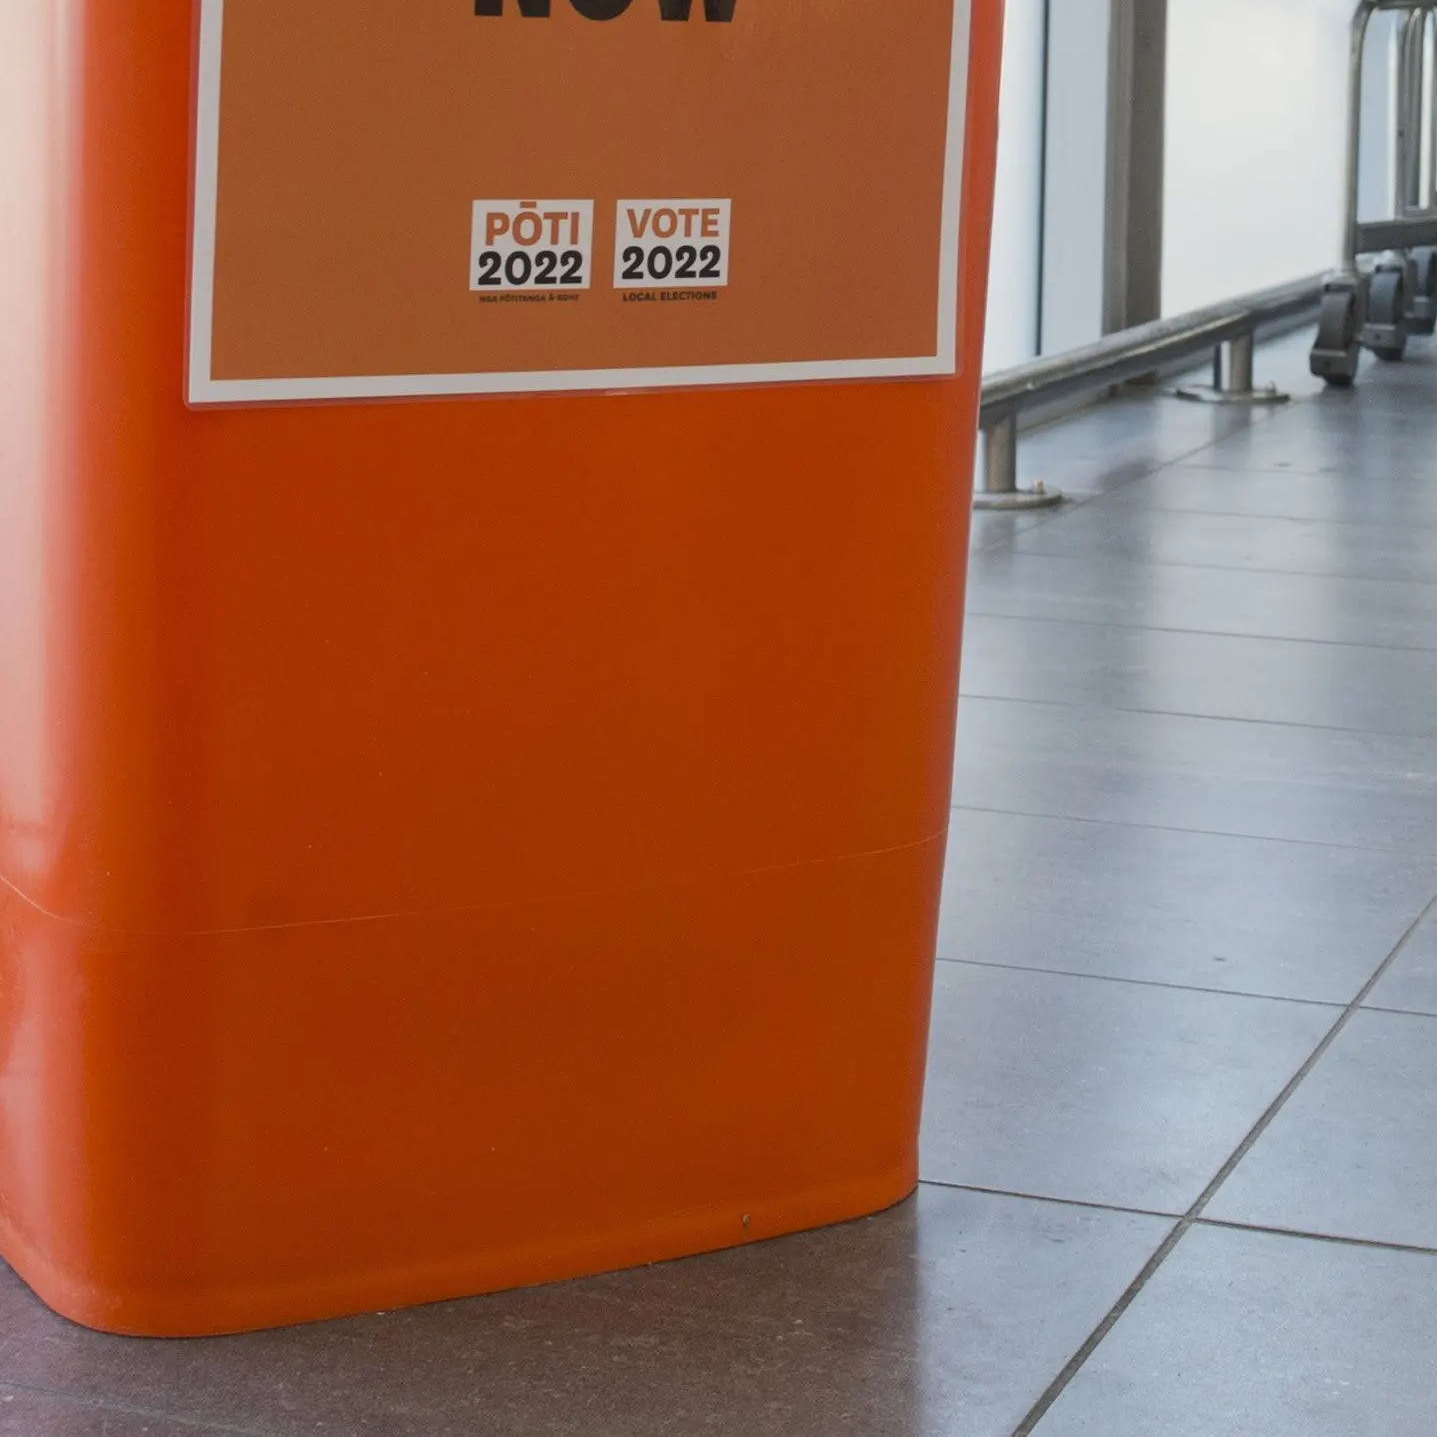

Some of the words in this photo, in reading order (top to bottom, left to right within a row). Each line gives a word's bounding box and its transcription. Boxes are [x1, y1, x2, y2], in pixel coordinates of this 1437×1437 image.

[484, 201, 580, 246] PŌTI
[626, 208, 720, 239] VOTE
[477, 250, 583, 286] 2022
[621, 245, 721, 280] 2022
[622, 291, 658, 302] LOCAL
[660, 290, 718, 302] ELECTIONS
